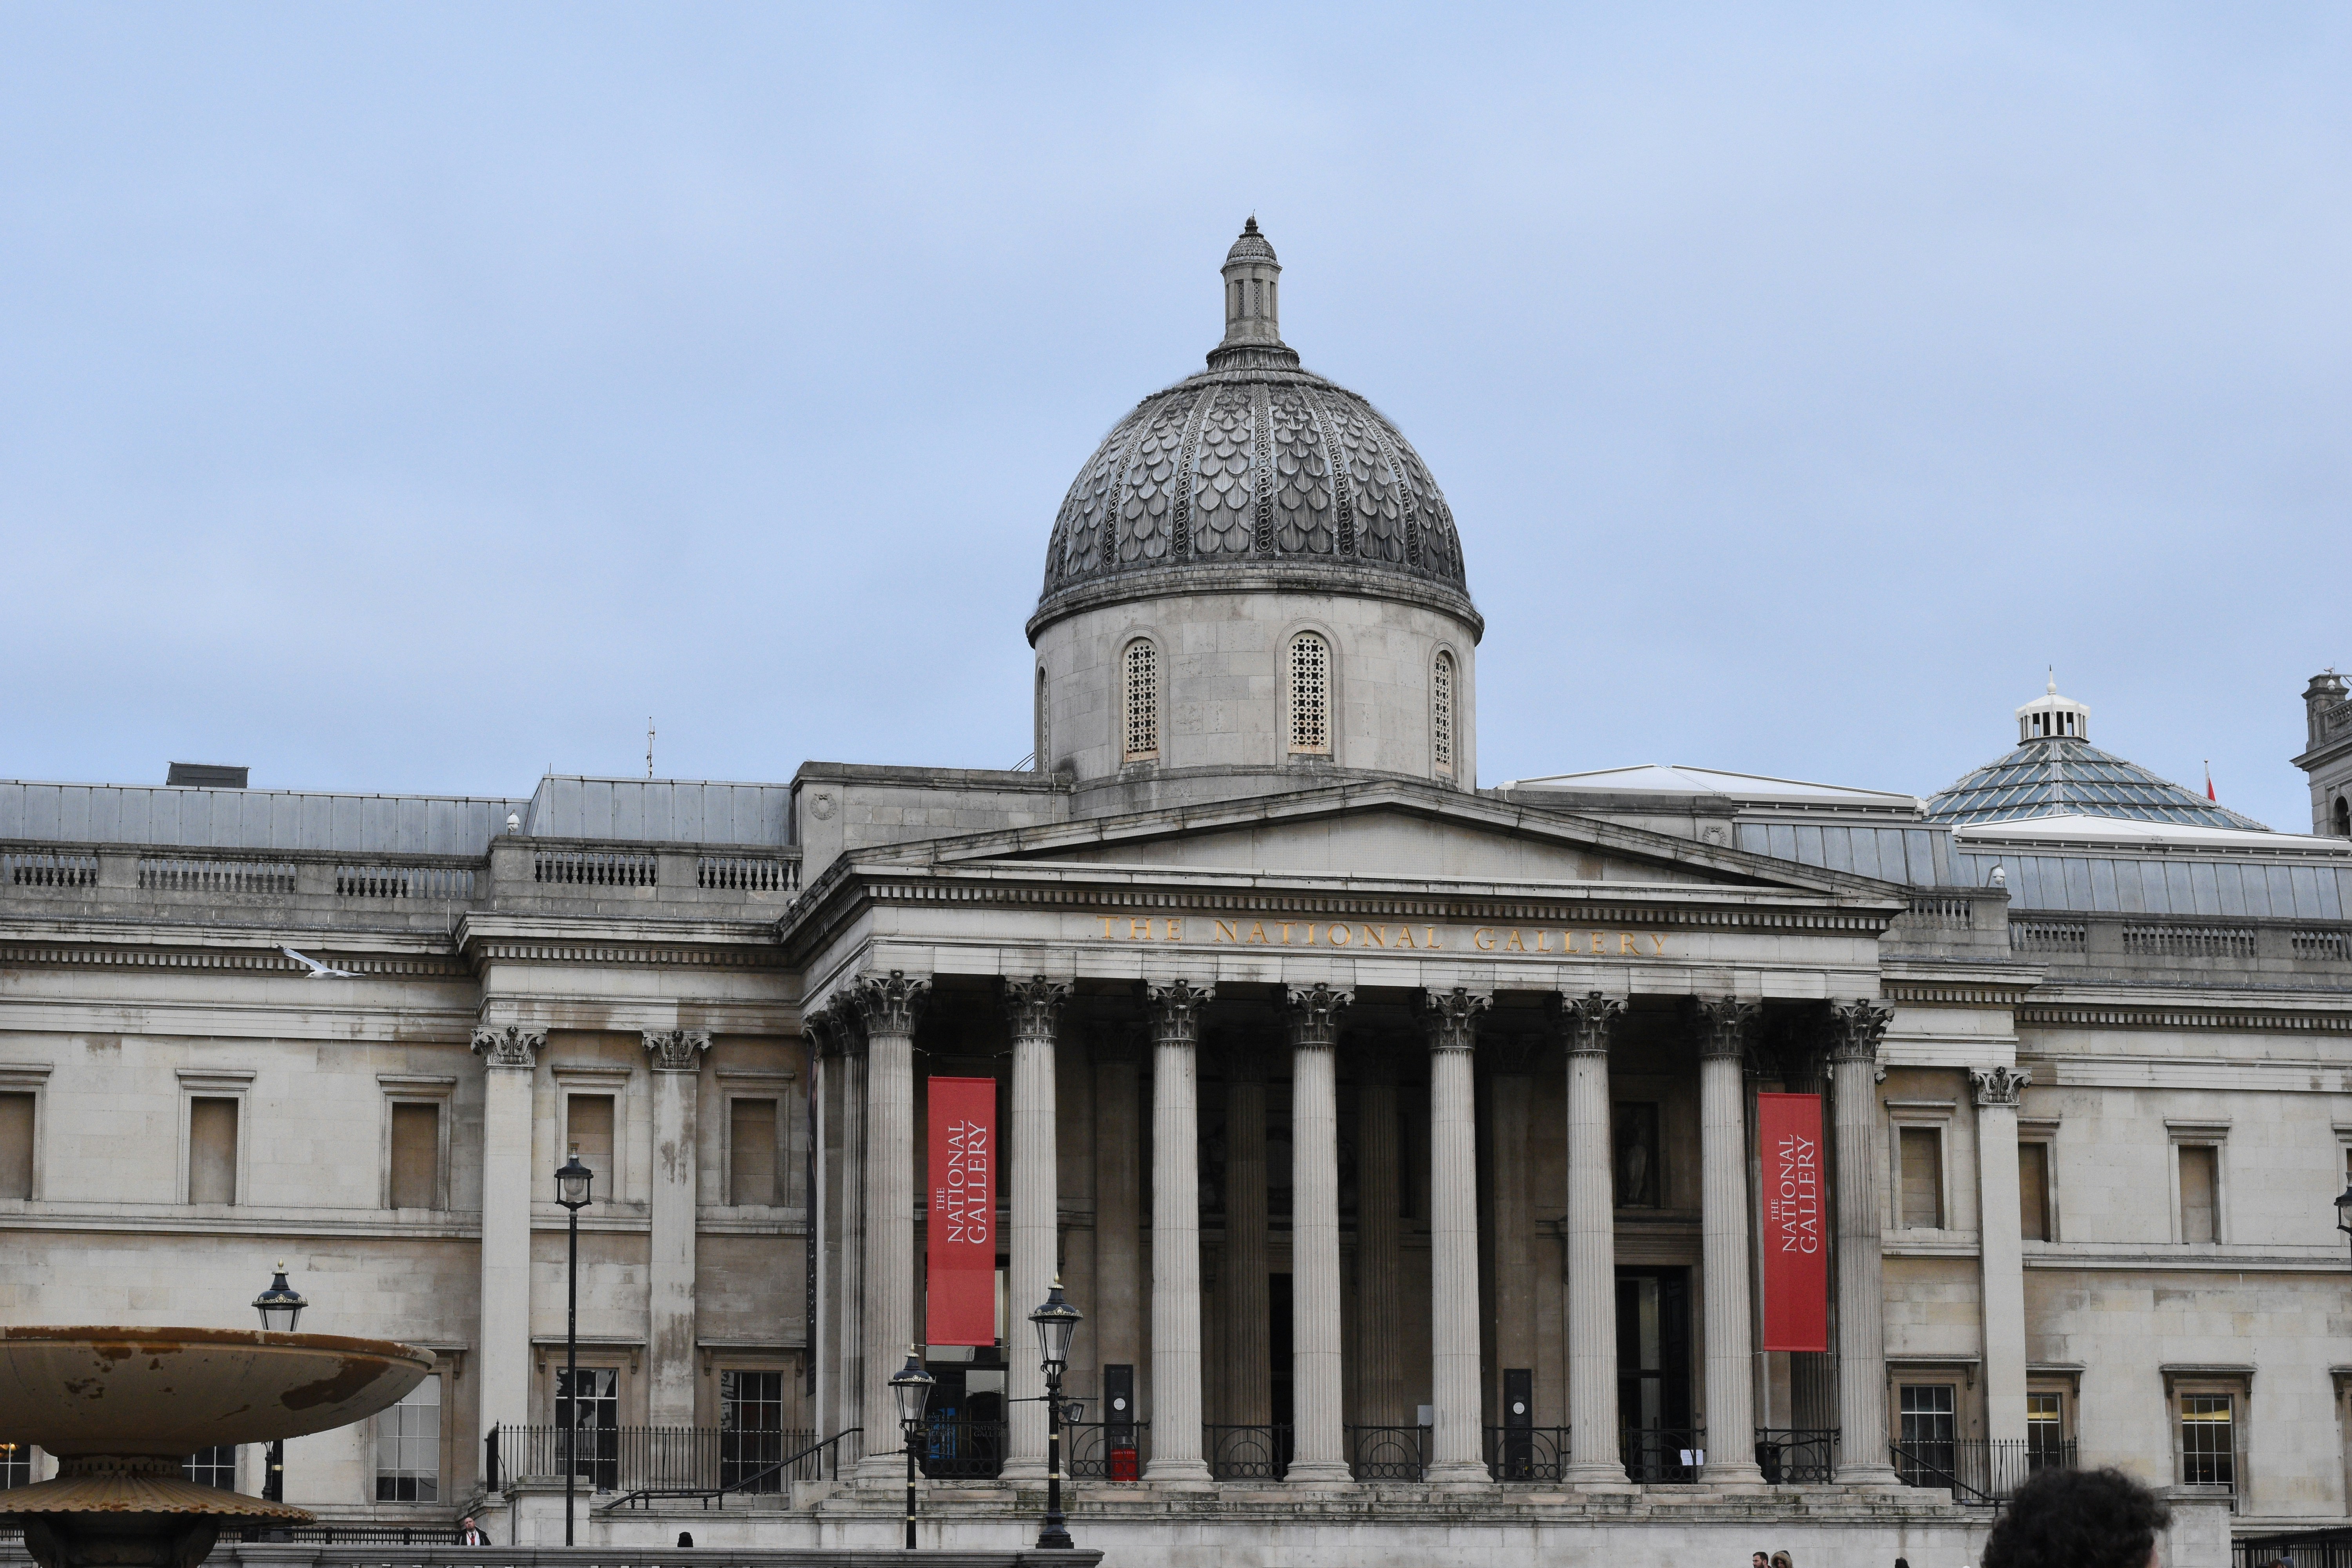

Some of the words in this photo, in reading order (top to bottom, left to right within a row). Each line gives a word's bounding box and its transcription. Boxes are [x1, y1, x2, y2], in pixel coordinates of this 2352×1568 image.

[1096, 915, 1182, 942] THE
[1215, 920, 1443, 950] NATIONAL
[1473, 927, 1669, 956] GALLERY
[936, 1187, 945, 1211] THE
[947, 1120, 964, 1243] NATIONAL
[967, 1120, 986, 1244] GALLERY
[1771, 1199, 1779, 1221] THE
[1779, 1134, 1797, 1253] NATIONAL
[1797, 1134, 1817, 1254] GALLERY
